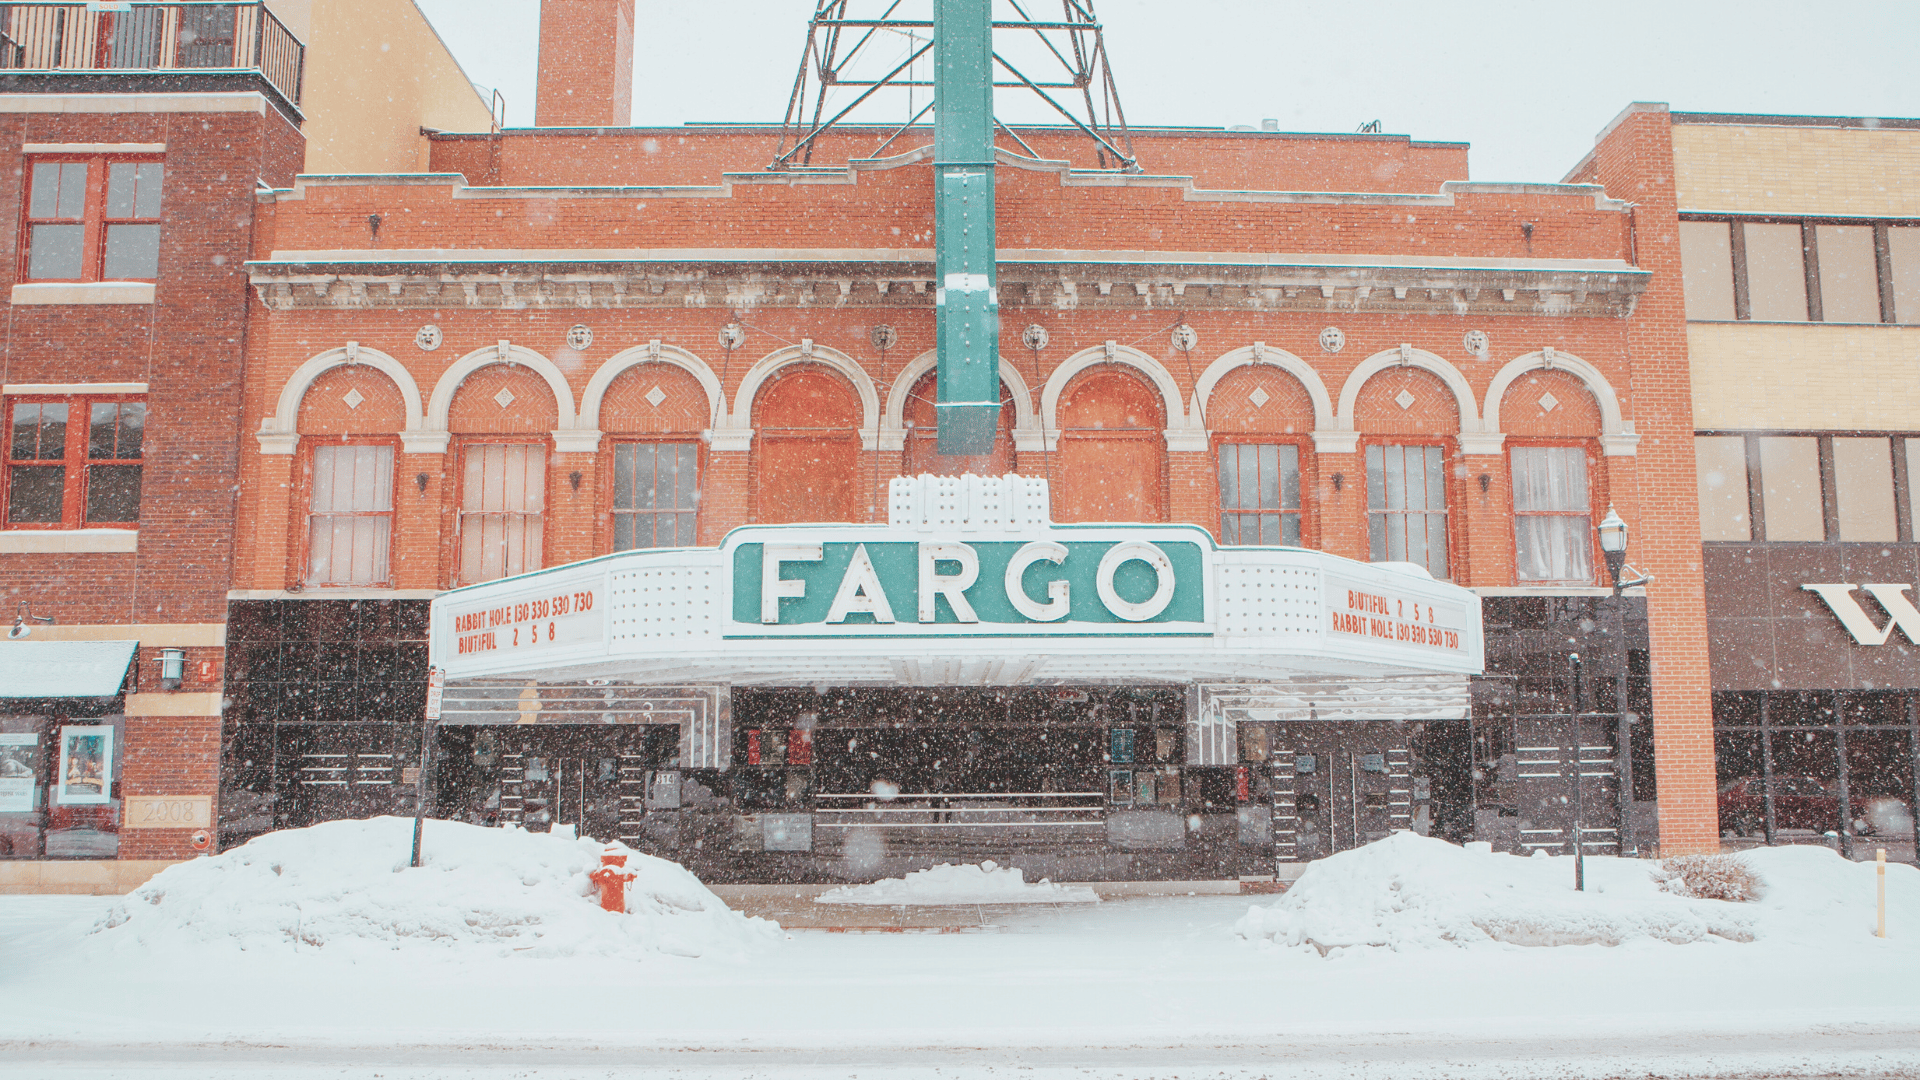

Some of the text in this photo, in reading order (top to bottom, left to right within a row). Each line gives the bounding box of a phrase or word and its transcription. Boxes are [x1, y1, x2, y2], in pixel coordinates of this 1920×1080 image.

[761, 540, 1176, 625] FARGO
[455, 611, 487, 633] RABBIT
[489, 606, 512, 627] HOLE
[531, 600, 550, 620] 330
[552, 595, 570, 617] 530
[573, 591, 593, 612] 730
[1348, 590, 1389, 615] BIUTIFUL
[1414, 603, 1420, 621] 5
[1428, 606, 1434, 624] 8
[458, 622, 555, 654] BIUTIFUL 2 5 8
[1332, 611, 1367, 635] RABBIT
[1370, 618, 1394, 639] HOLE
[1411, 625, 1426, 644] 330
[1428, 628, 1443, 647] 530
[1444, 631, 1459, 649] 730
[143, 802, 194, 821] 2008
